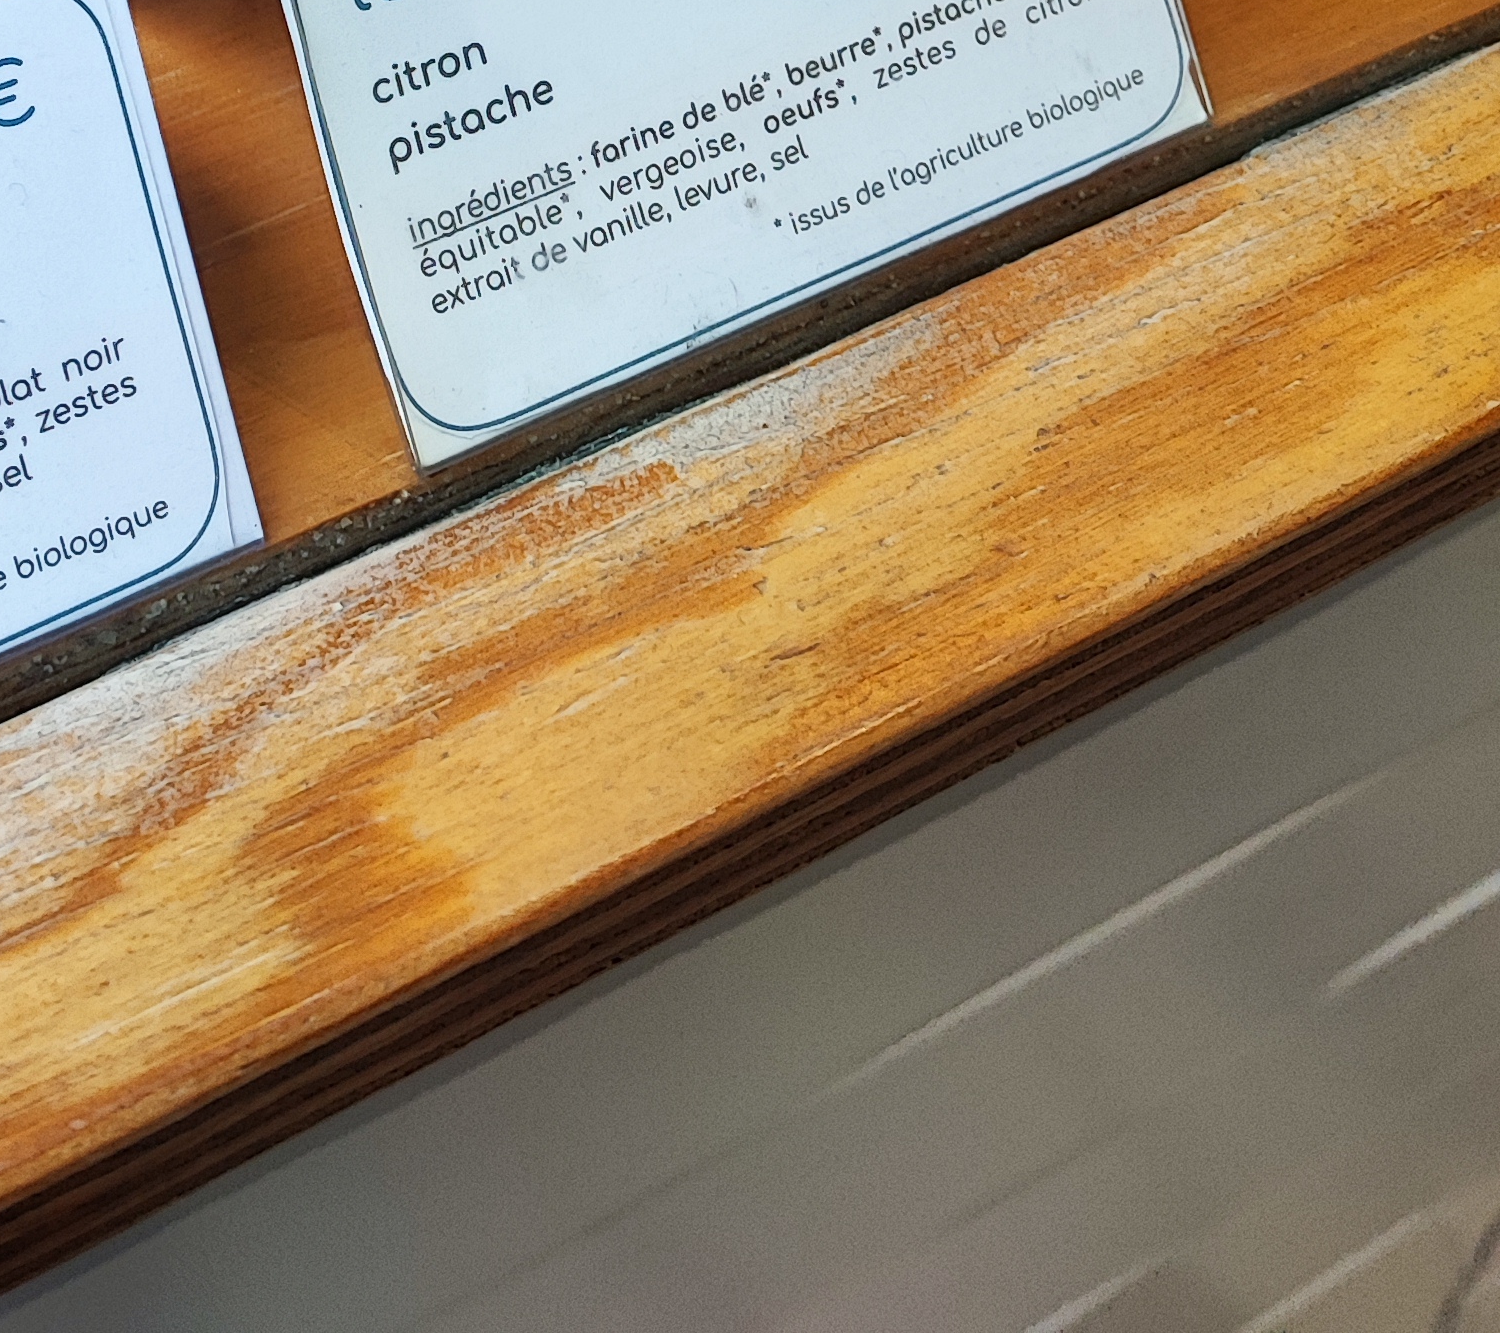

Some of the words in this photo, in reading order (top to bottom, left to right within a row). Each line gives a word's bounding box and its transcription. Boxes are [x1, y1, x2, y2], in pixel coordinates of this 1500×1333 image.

[372, 42, 488, 104] citron
[599, 130, 746, 201] vergeoise,
[873, 41, 957, 89] zestes
[974, 18, 1007, 45] de
[388, 79, 554, 175] pistache
[789, 195, 850, 235] issus
[855, 178, 886, 206] de
[887, 118, 1023, 191] l'agriculture
[1027, 66, 1145, 128] biologique
[409, 160, 576, 249] ingrédients
[590, 119, 675, 168] farine
[682, 102, 717, 131] de
[432, 258, 526, 314] extrait
[531, 242, 568, 271] de
[572, 195, 672, 255] vanille,
[674, 152, 765, 212] levure,
[769, 138, 808, 171] sel
[35, 373, 137, 434] zestes
[62, 335, 124, 383] noir
[13, 498, 169, 581] biologique
